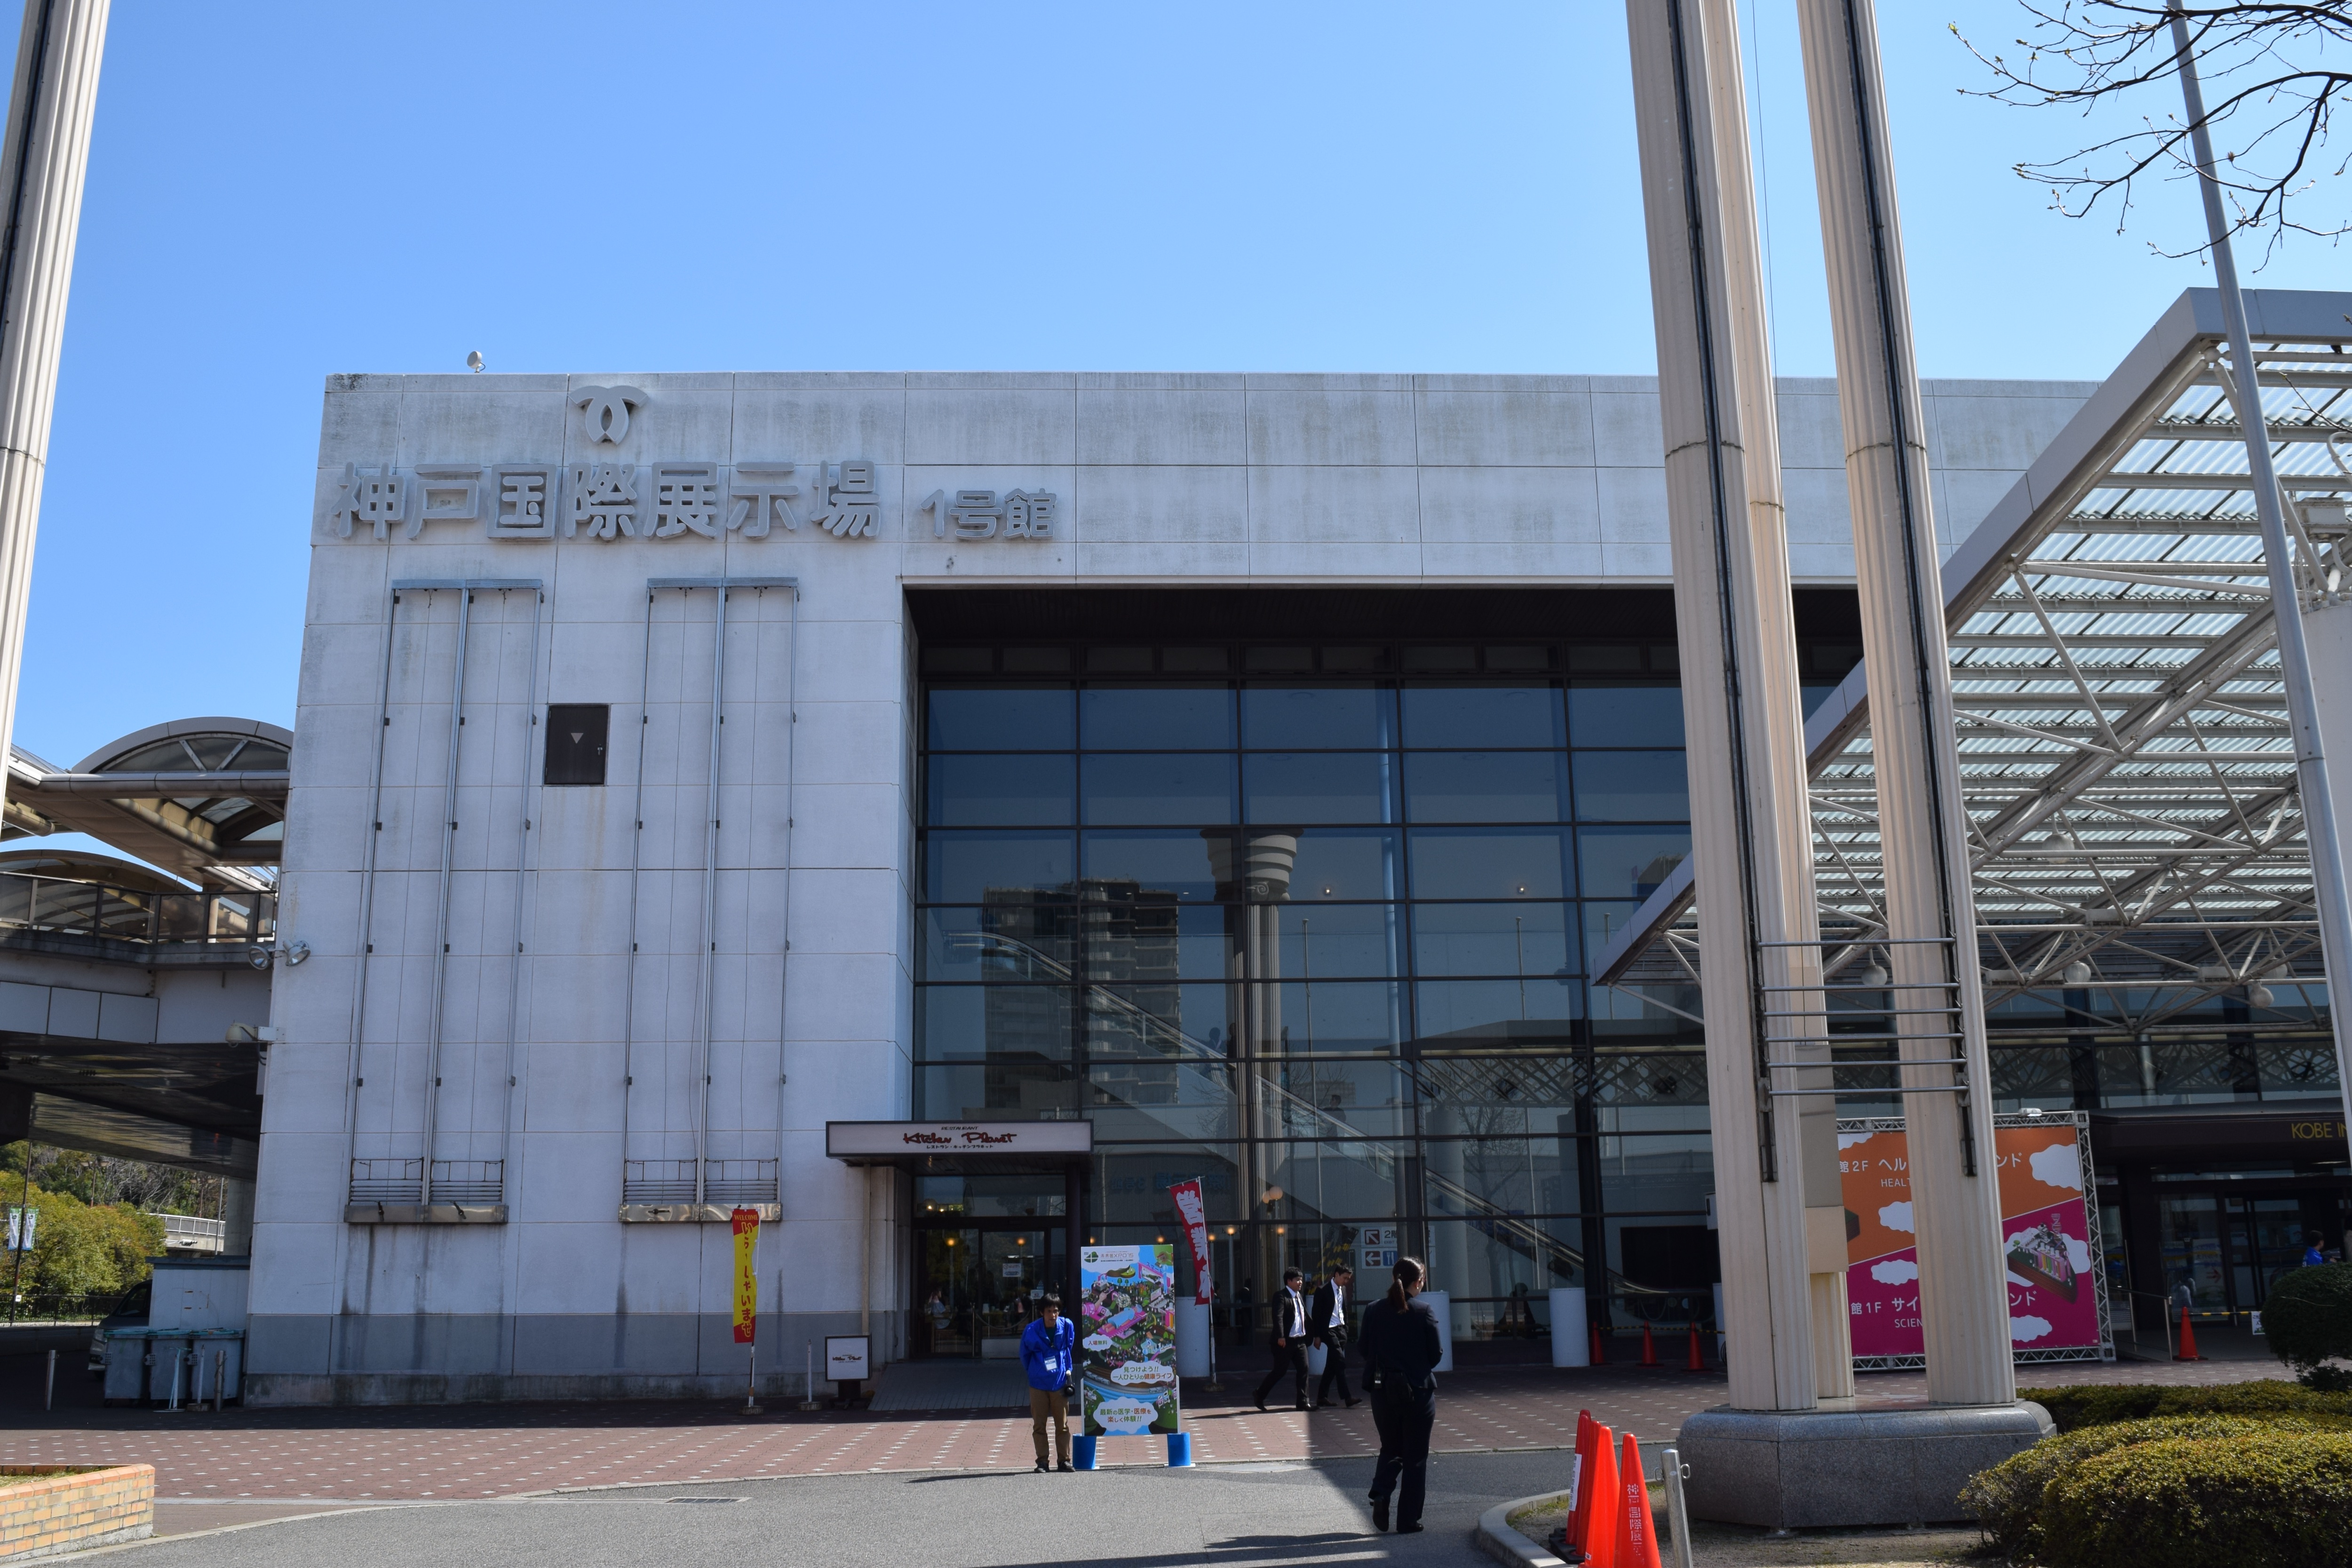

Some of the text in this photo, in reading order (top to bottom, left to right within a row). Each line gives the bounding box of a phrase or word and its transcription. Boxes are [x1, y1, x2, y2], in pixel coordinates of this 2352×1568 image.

[331, 460, 1057, 541] 神戸国際展示場 1号館
[2291, 1122, 2333, 1139] KOBE
[1878, 1157, 1907, 1171] ヘル
[1996, 1153, 2022, 1168] ンド
[1891, 1296, 1918, 1312] サイ
[2010, 1290, 2036, 1306] ンド
